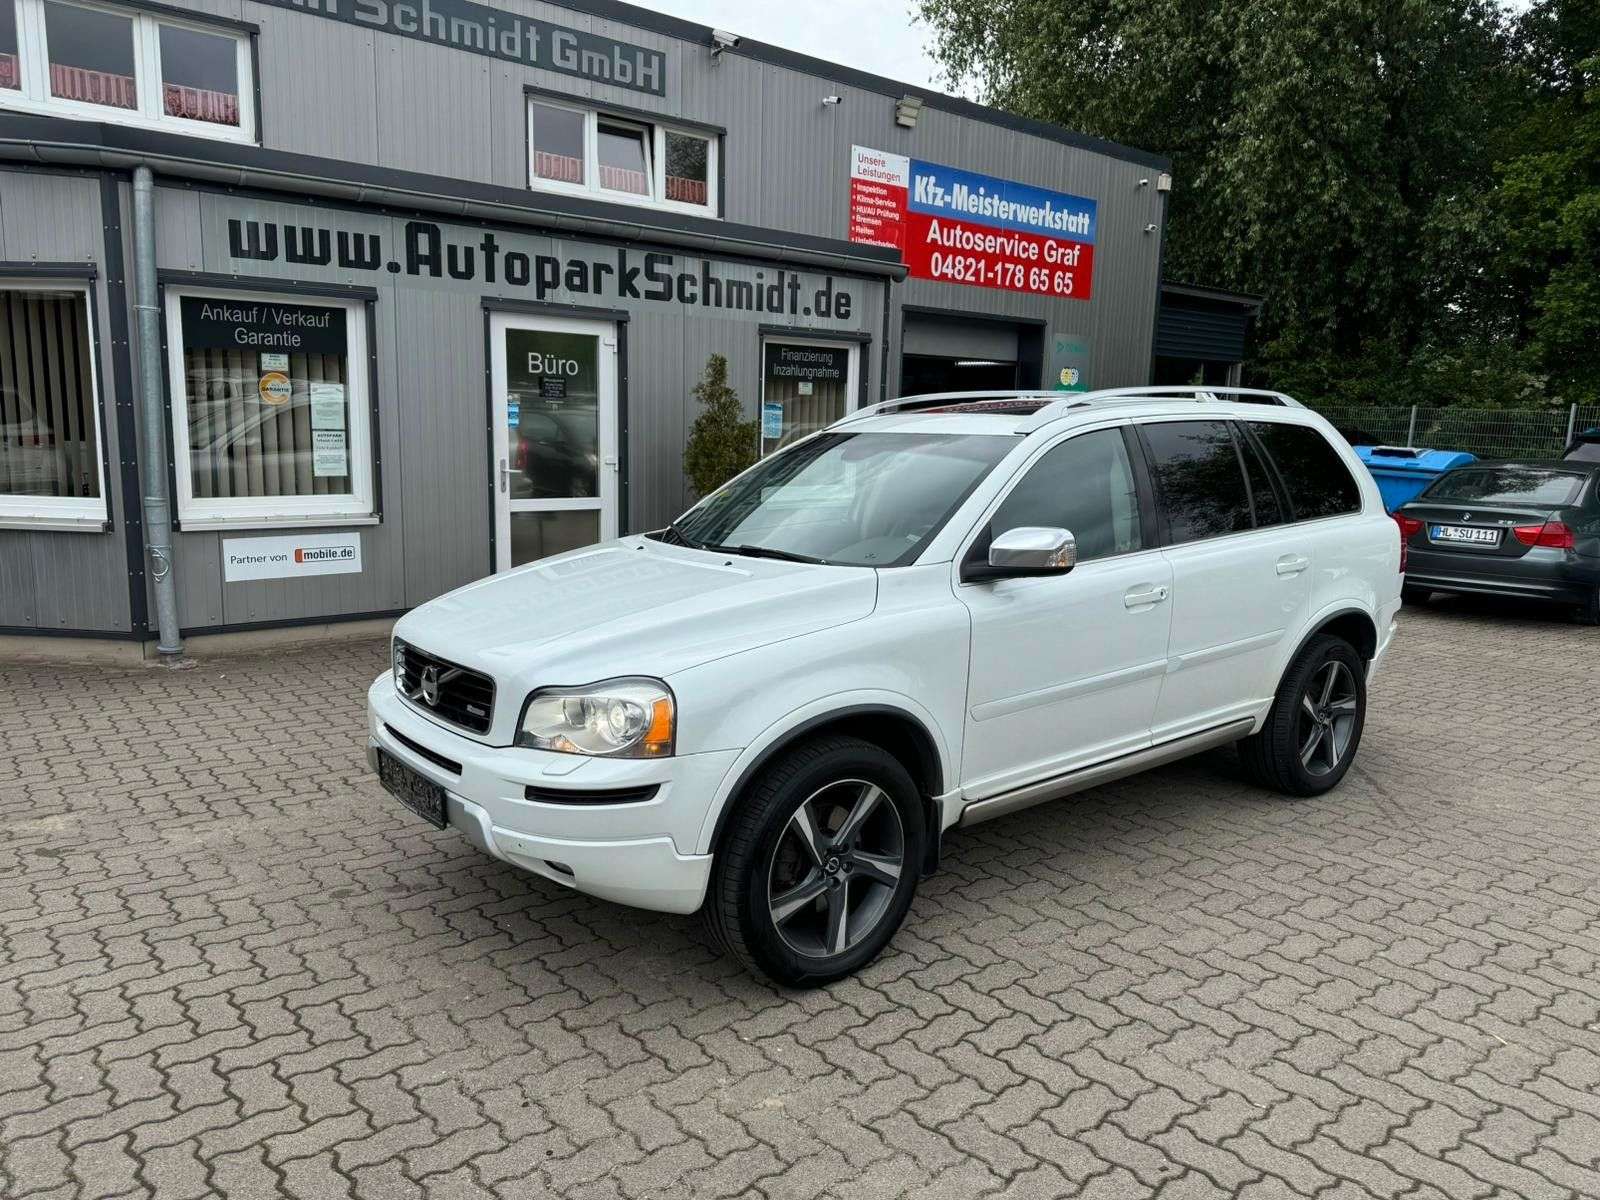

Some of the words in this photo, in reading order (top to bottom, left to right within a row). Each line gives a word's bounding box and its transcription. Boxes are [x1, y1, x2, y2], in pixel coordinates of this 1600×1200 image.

[353, 0, 541, 62] Schmidt
[552, 30, 660, 91] GmbH
[858, 153, 887, 167] Unsere
[857, 165, 901, 183] Leistungen
[914, 174, 1091, 235] Kfz-Meisterwerkstatt
[926, 219, 1039, 260] Autoservice
[1043, 239, 1081, 267] Graf
[228, 219, 851, 320] www.AutoparkSchmidt.de
[930, 252, 1024, 288] 04821-178
[1029, 267, 1050, 292] 65
[1053, 270, 1074, 295] 65
[200, 303, 259, 324] Ankauf
[271, 307, 331, 329] Verkauf
[234, 327, 301, 347] Garantie
[527, 351, 579, 376] Büro
[781, 347, 834, 366] Finanzierung
[773, 363, 840, 380] Inzahlungnahme
[1438, 526, 1452, 537] HL
[1459, 528, 1473, 539] SU
[1475, 530, 1495, 541] 111
[230, 554, 266, 565] Partner
[270, 553, 288, 562] von
[303, 547, 354, 560] mobile.de
